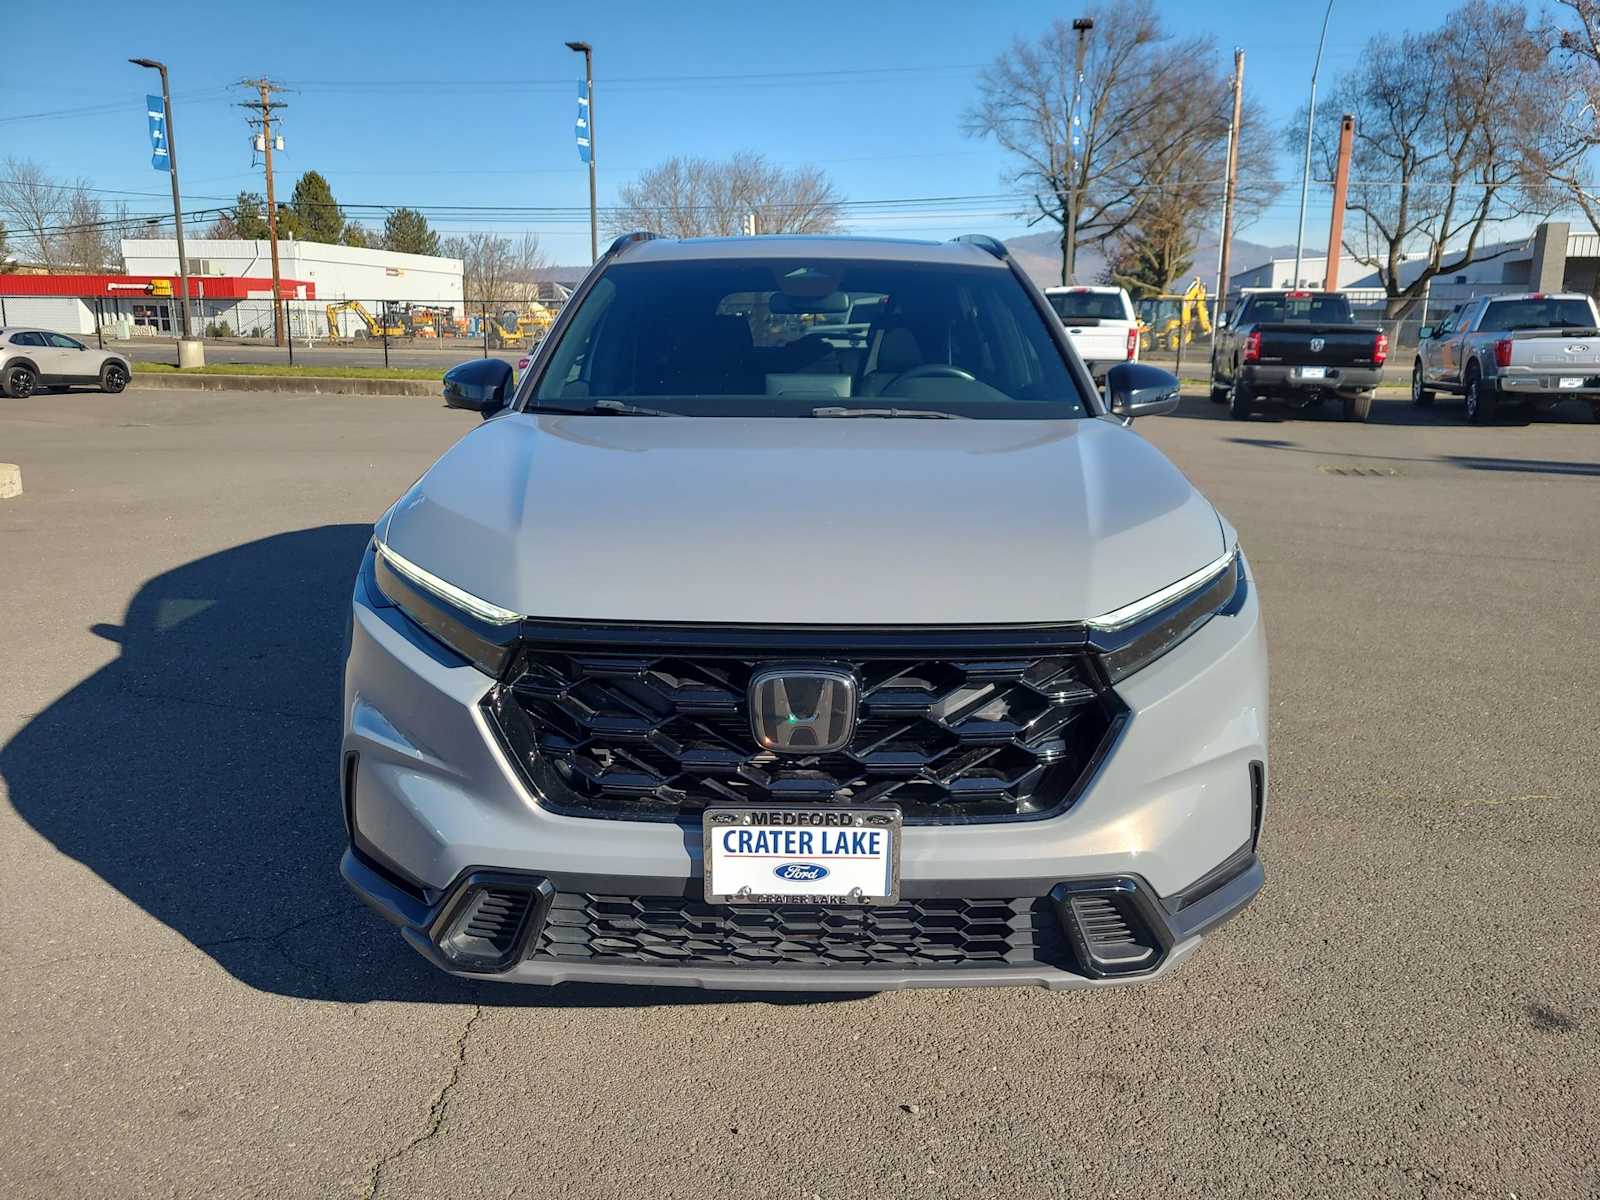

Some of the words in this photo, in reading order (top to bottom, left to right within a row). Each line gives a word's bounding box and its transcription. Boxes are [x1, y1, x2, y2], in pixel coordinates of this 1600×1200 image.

[751, 812, 853, 826] MEDFORD
[723, 829, 813, 854] CRATER
[822, 831, 880, 855] LAKE
[783, 864, 819, 880] Ford
[757, 894, 810, 904] CRATER
[813, 895, 848, 905] LAKE
